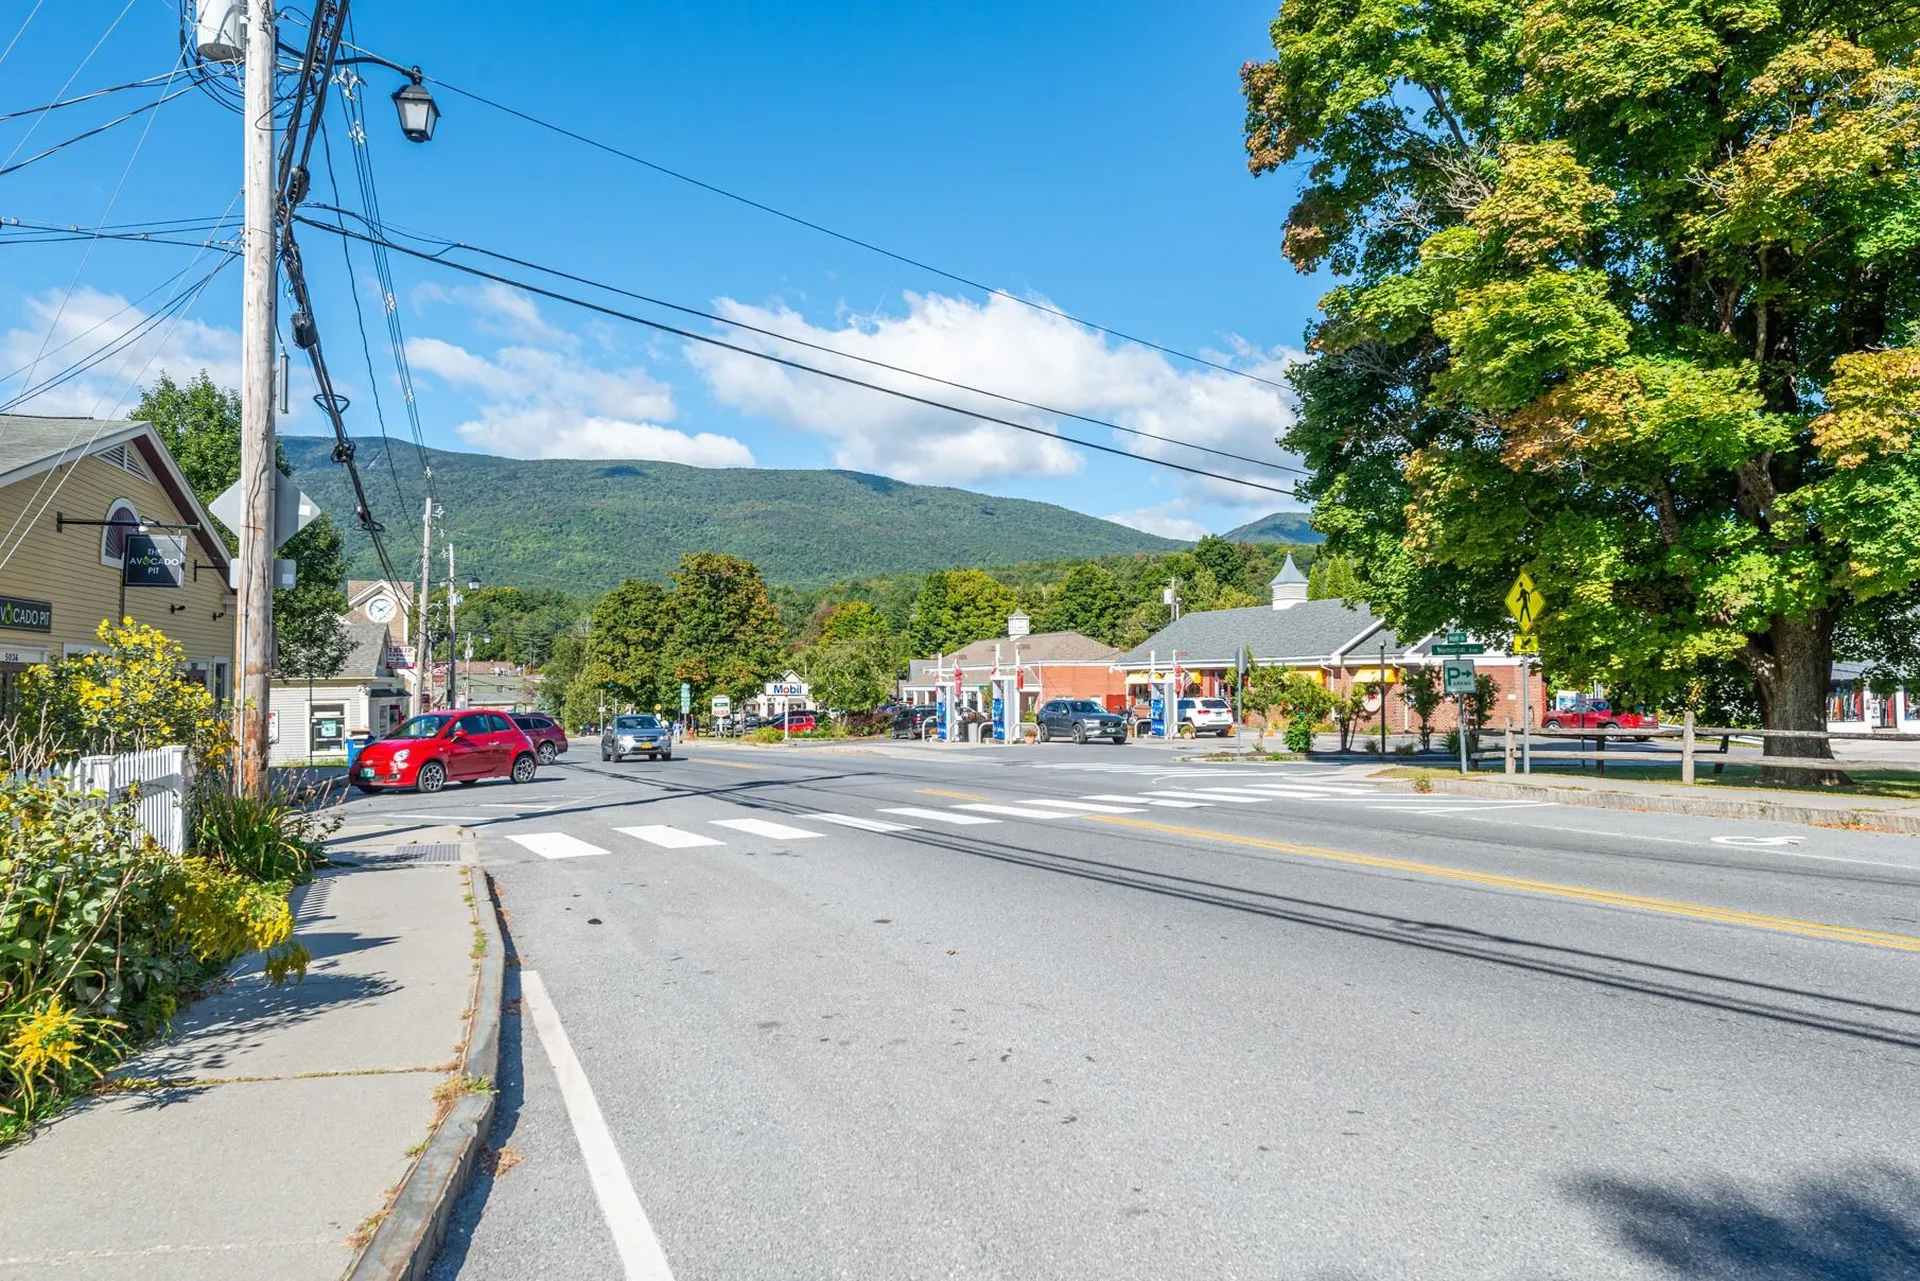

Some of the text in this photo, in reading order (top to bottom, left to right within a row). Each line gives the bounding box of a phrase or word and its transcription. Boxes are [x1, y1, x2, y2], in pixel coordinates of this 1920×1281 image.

[147, 548, 163, 556] THE
[129, 556, 179, 566] AVOCADO
[147, 567, 159, 575] PIT
[39, 611, 50, 626] PIT
[773, 684, 802, 694] Mobil
